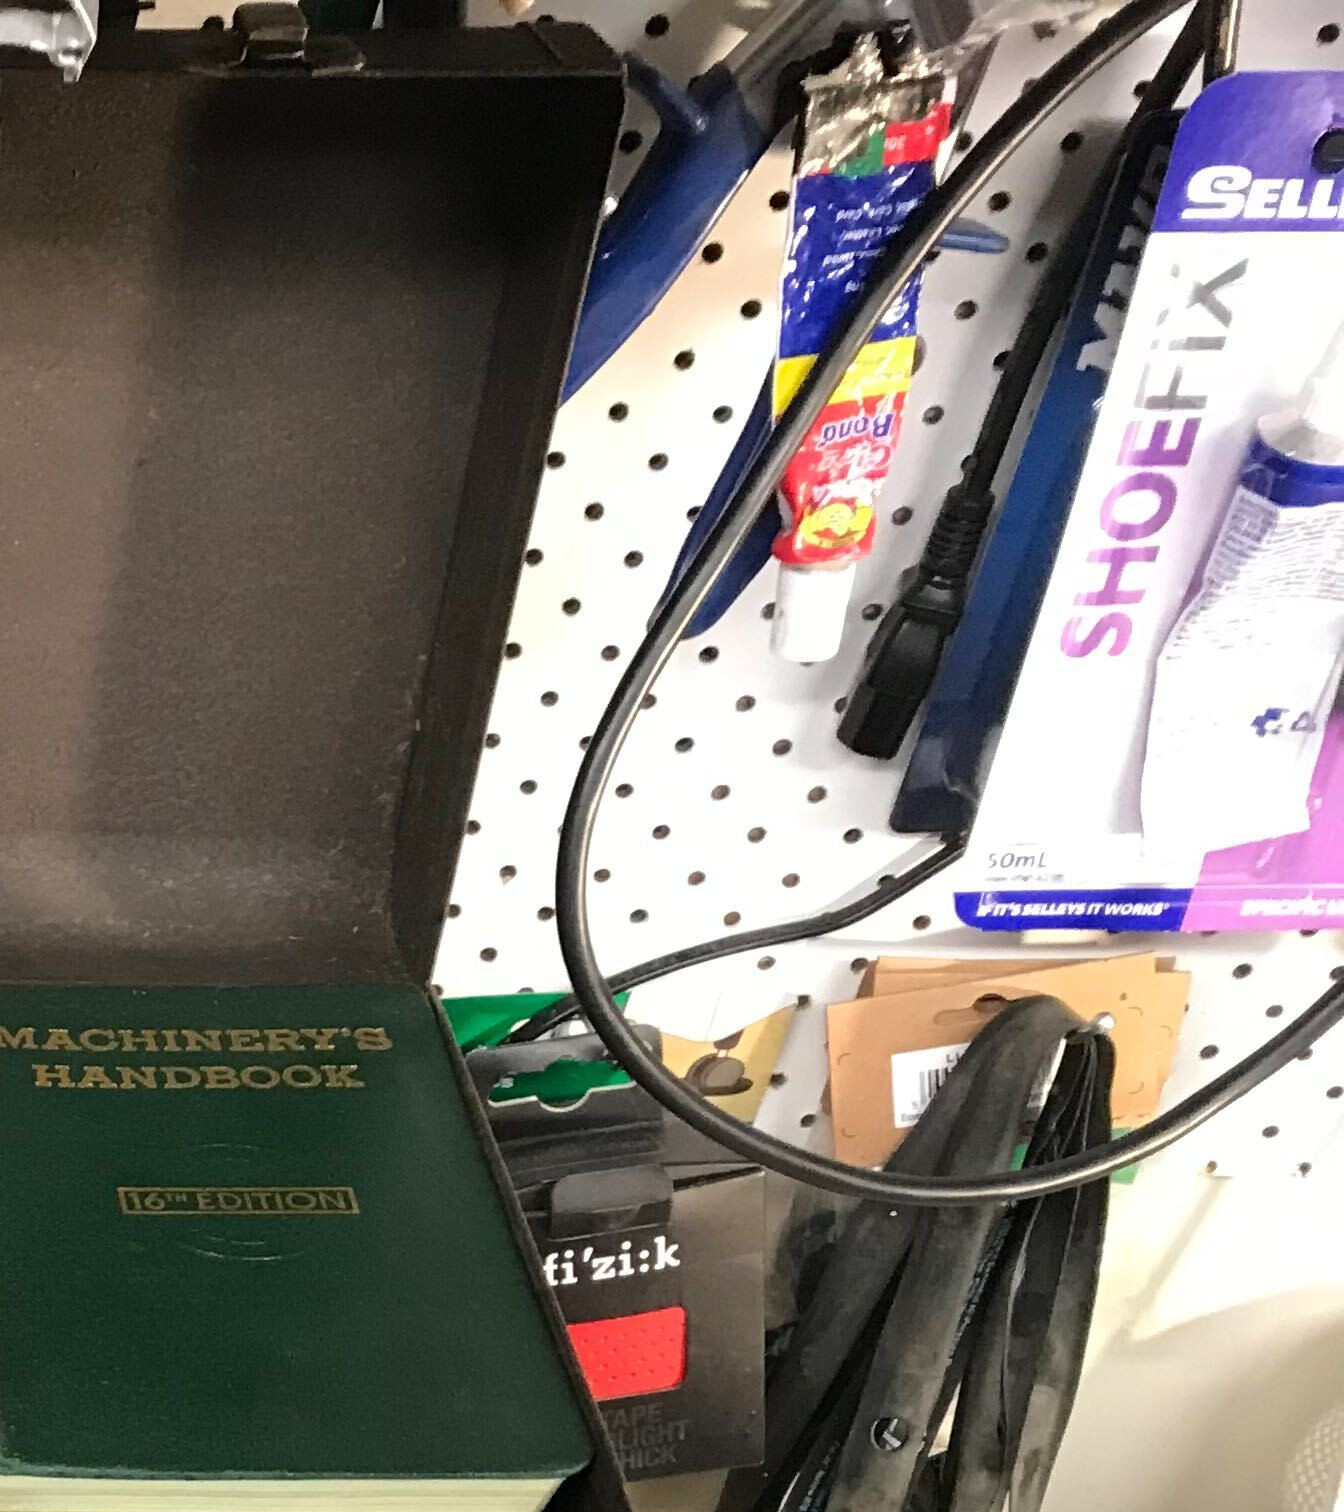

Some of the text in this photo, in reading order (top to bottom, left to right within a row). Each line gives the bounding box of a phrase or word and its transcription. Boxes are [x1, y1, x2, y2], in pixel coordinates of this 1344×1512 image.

[1180, 165, 1344, 220] SELL
[987, 852, 1048, 868] 50mL
[1021, 903, 1085, 916] SELLEYS
[1087, 903, 1100, 915] IT
[34, 1064, 366, 1090] HANDBOOK
[194, 1190, 349, 1212] EDITION
[609, 1420, 689, 1448] LIGHT
[617, 1445, 677, 1468] HICK
